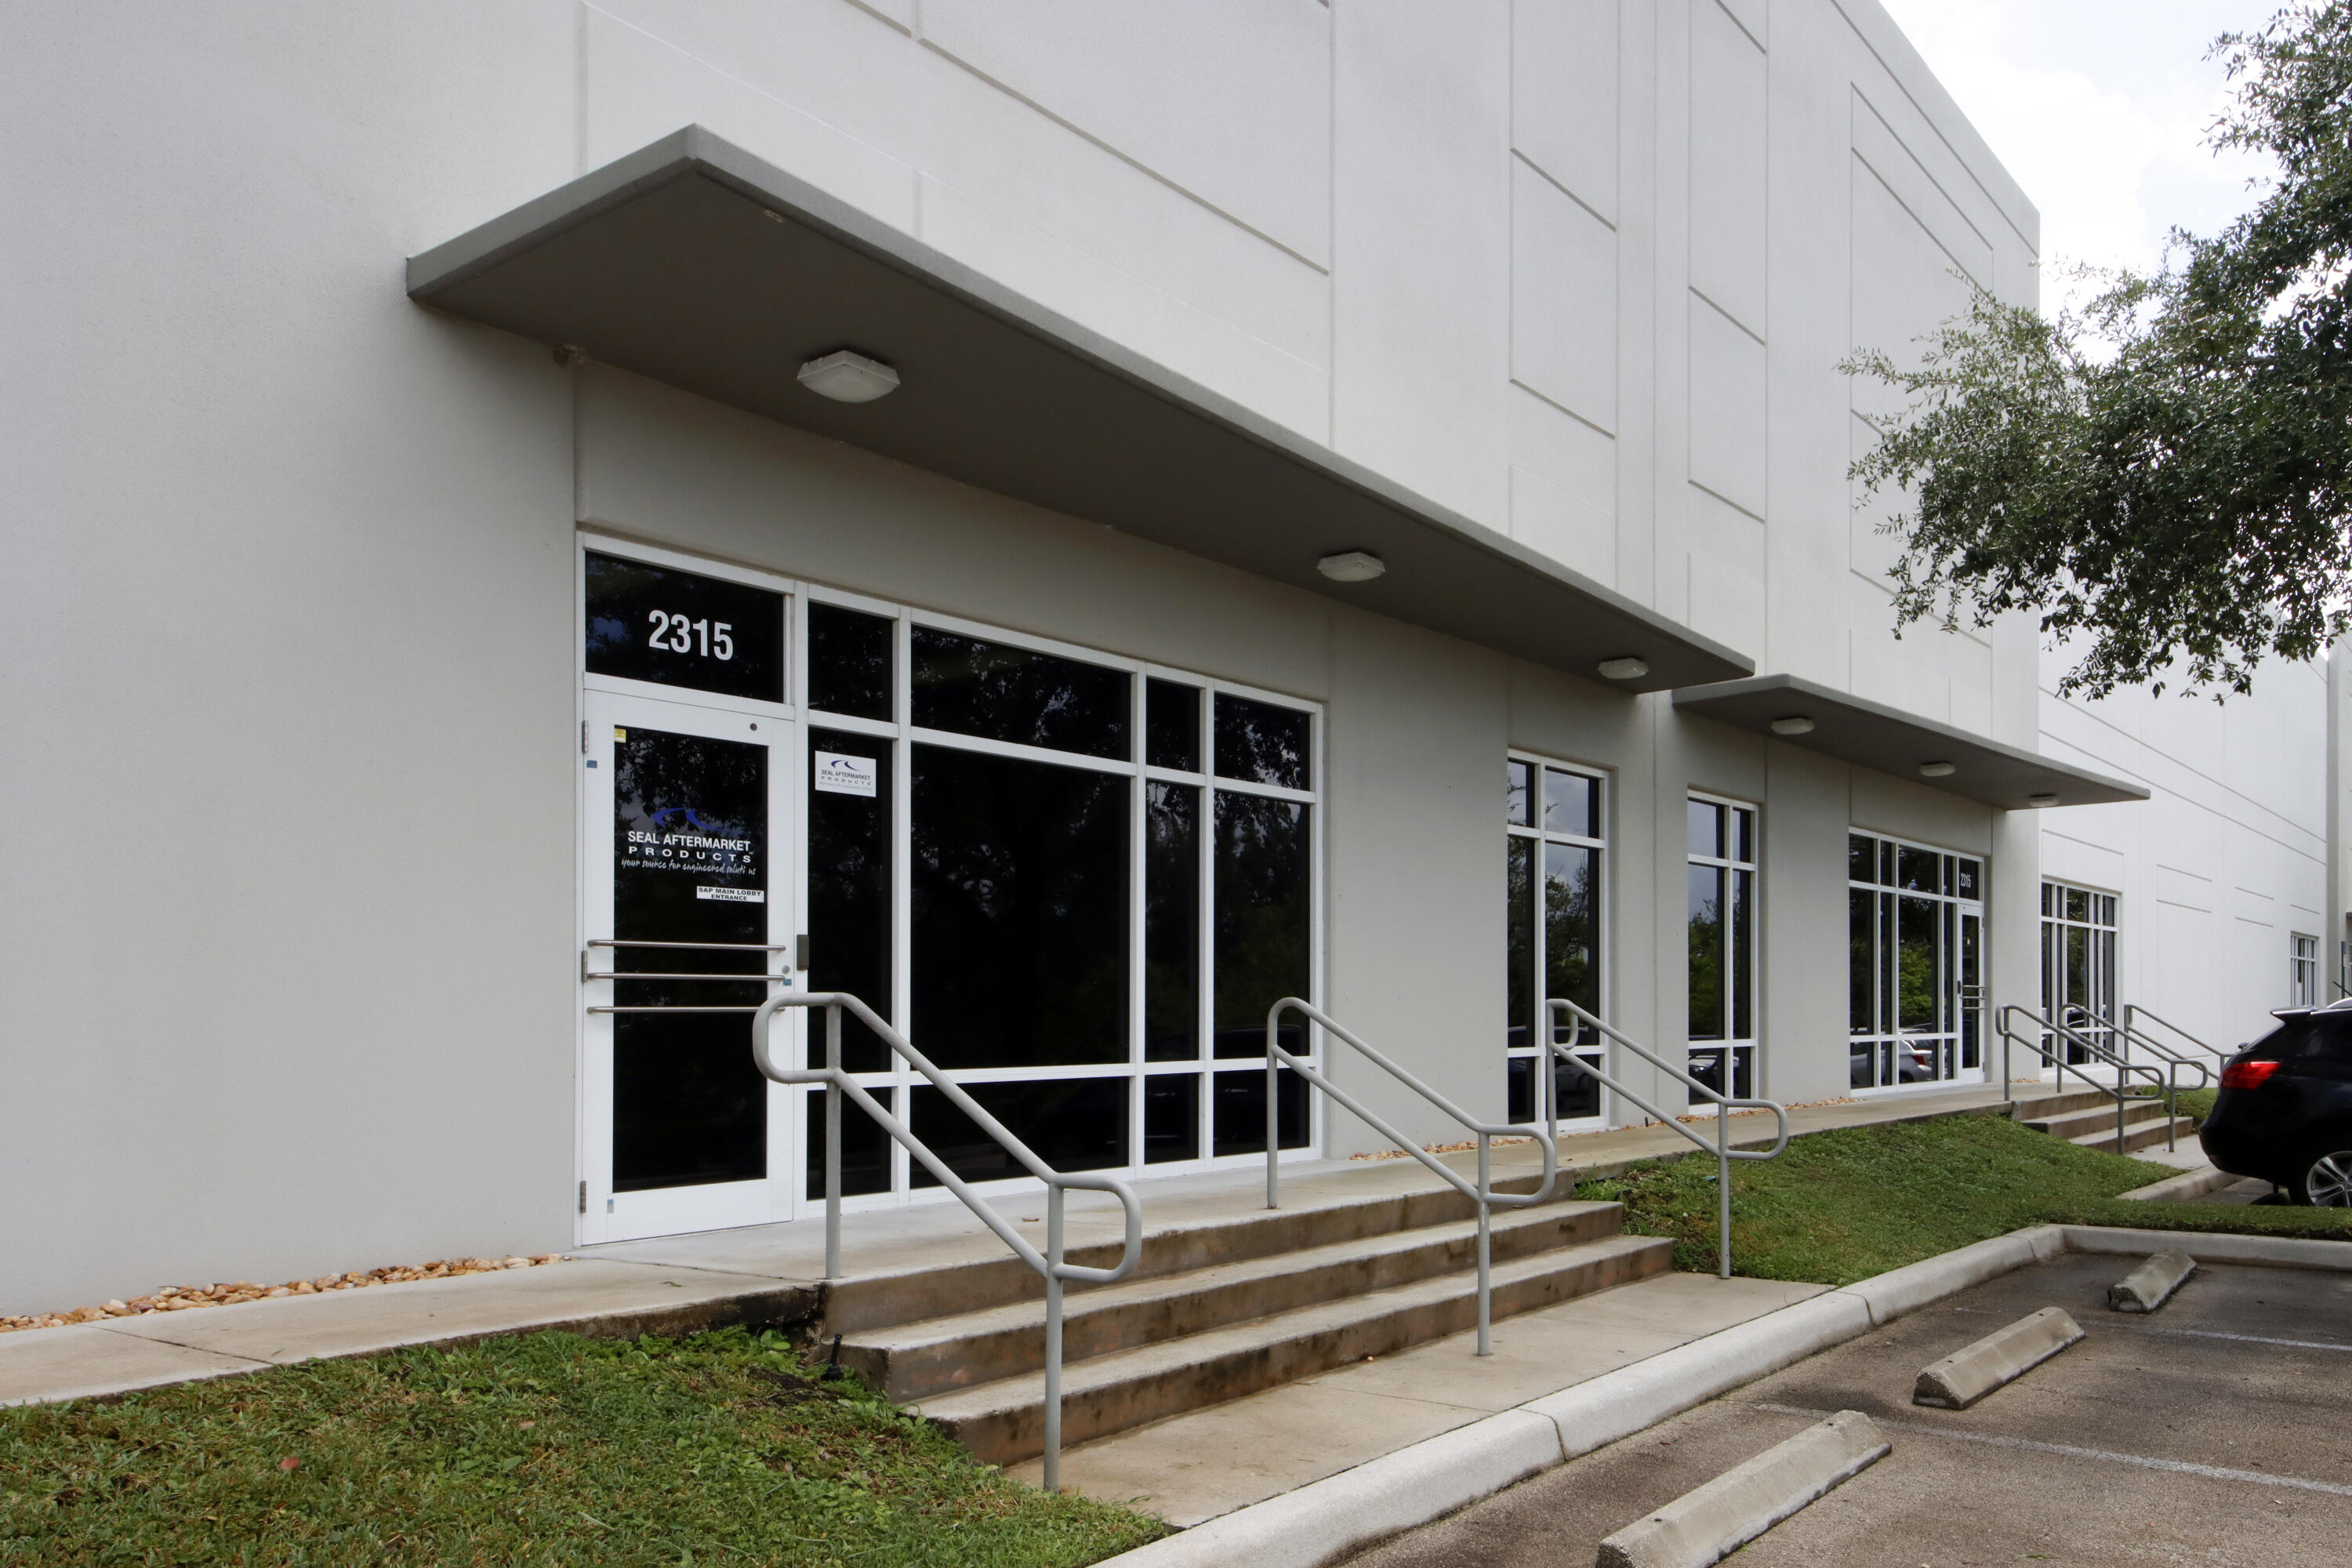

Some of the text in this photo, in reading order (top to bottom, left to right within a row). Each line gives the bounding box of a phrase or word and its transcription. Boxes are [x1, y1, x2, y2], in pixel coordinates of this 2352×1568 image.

[648, 609, 734, 661] 2315
[822, 776, 871, 786] PRODUCTS
[835, 771, 870, 780] AFTERMARKET
[628, 830, 751, 851] SEAL AFTERMARKET
[628, 846, 751, 863] PRODUCTS
[621, 858, 757, 876] your source for engineered solutins
[1961, 873, 1971, 888] 2315
